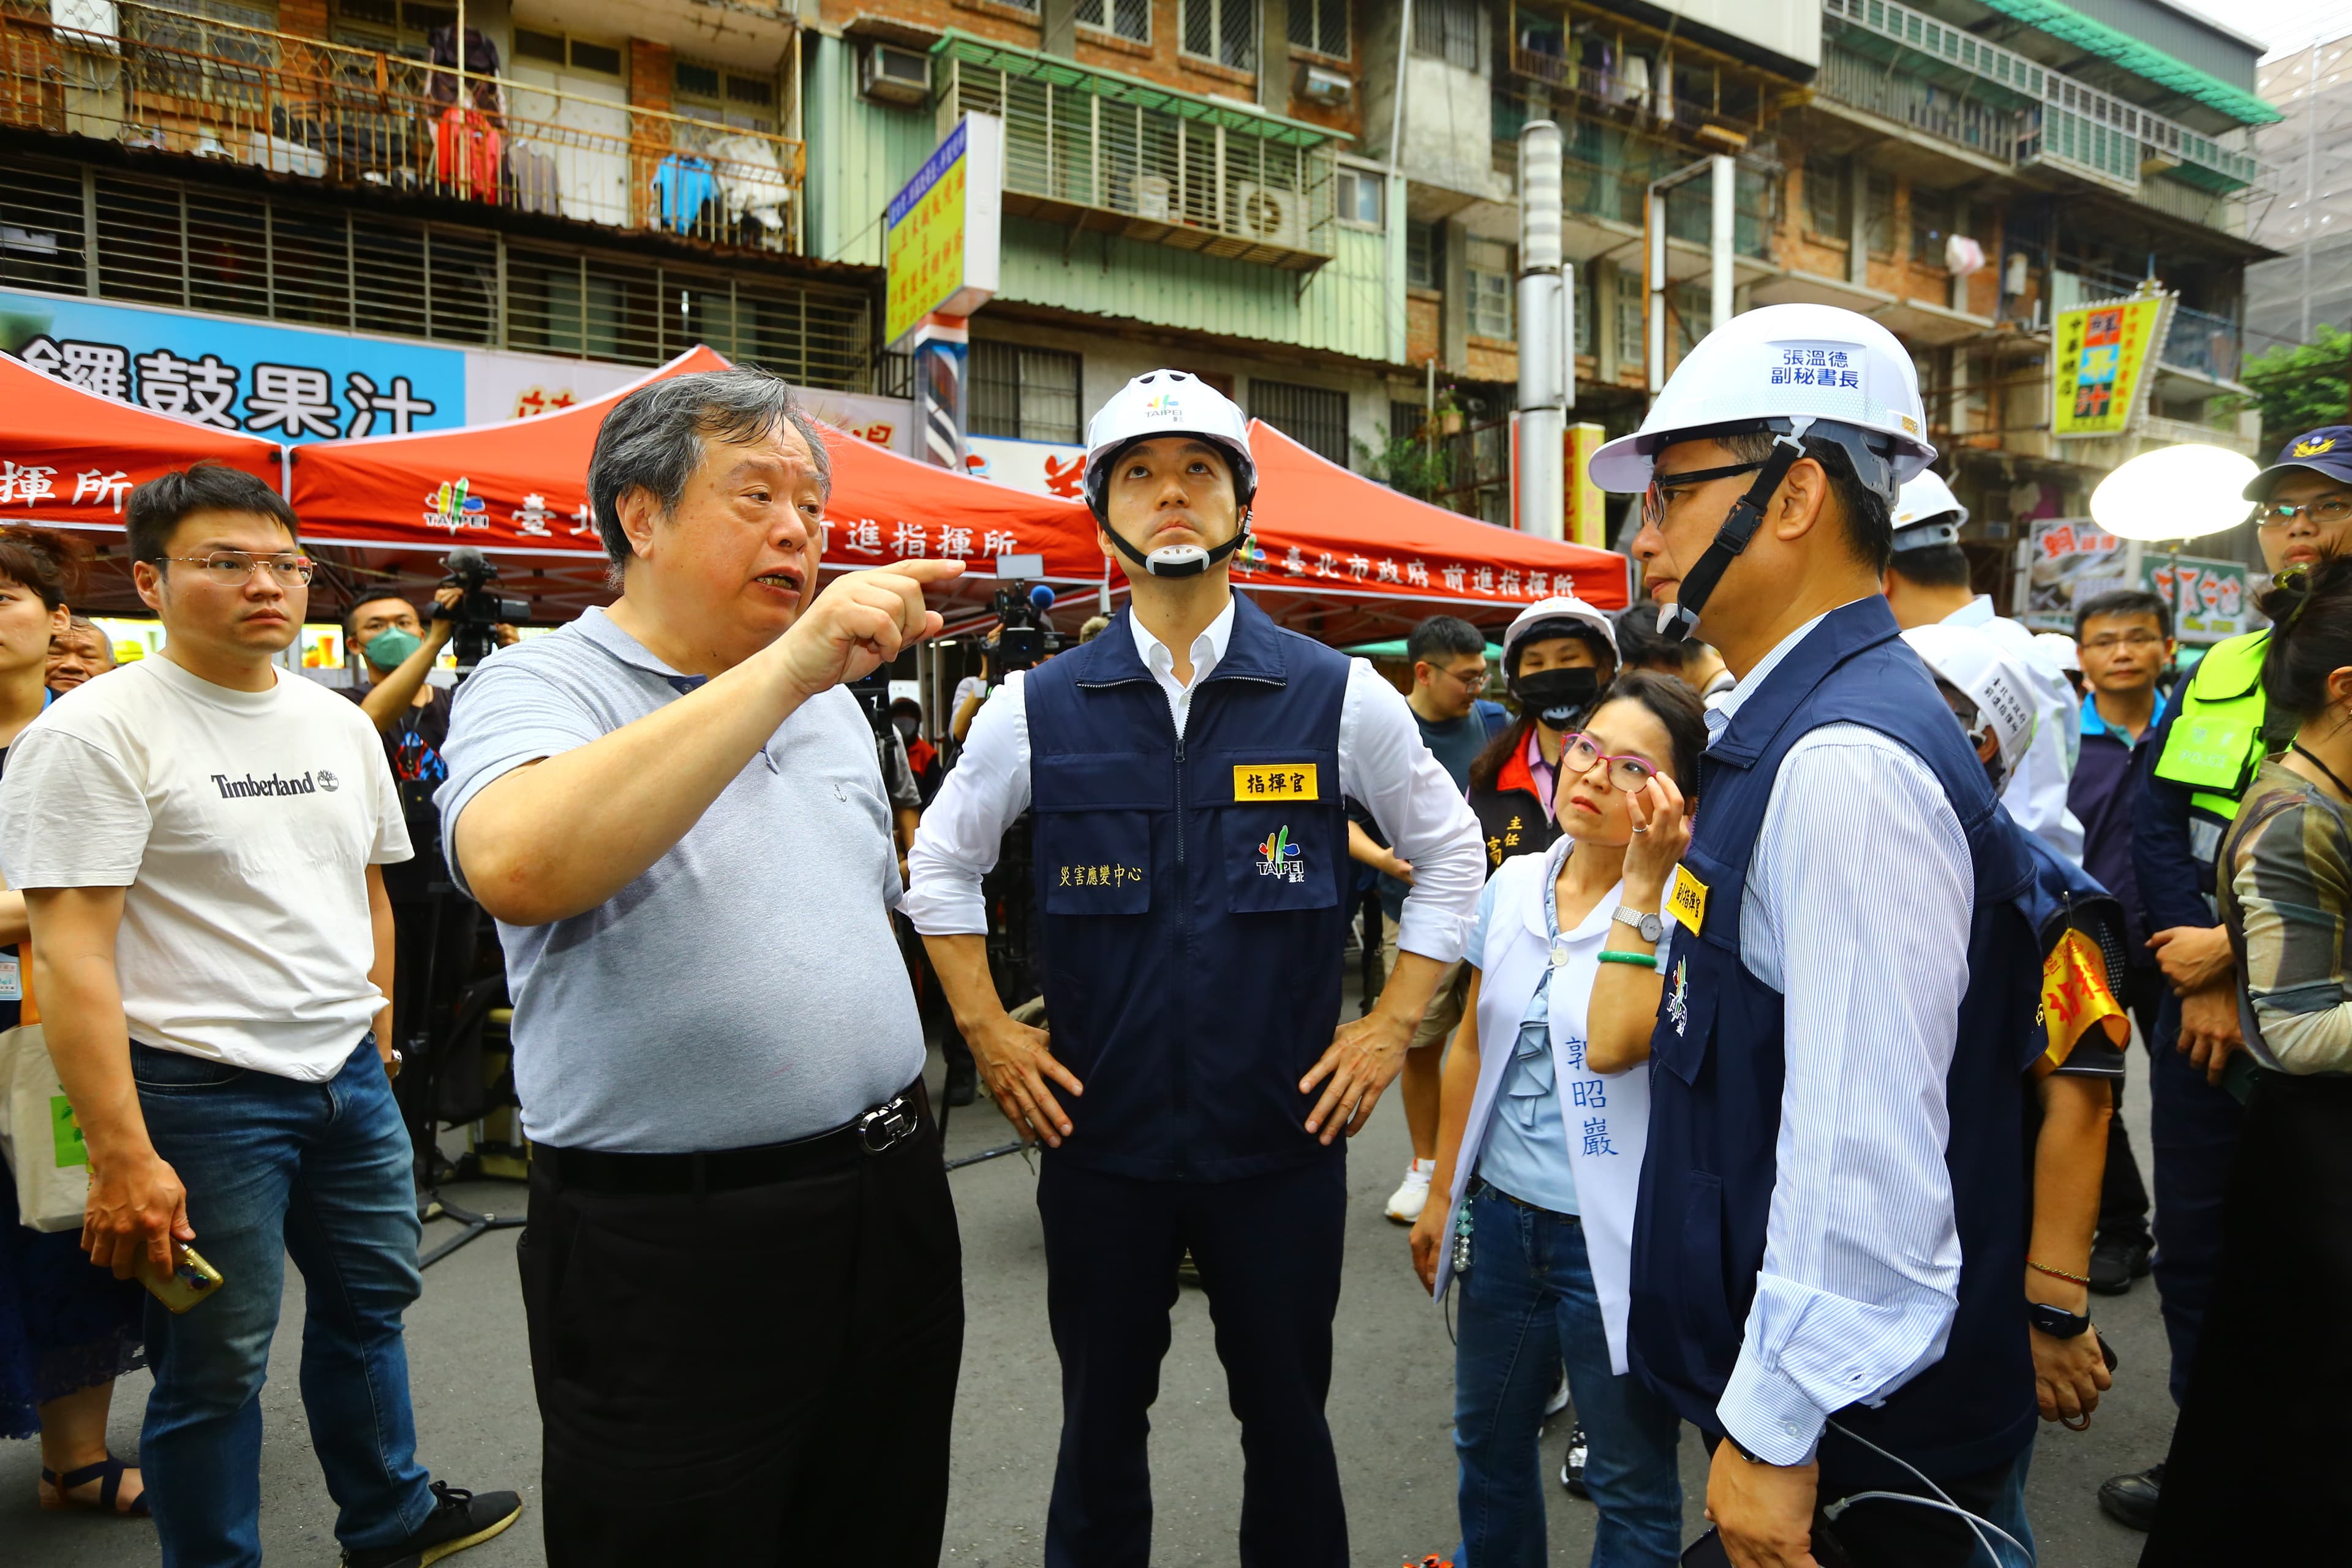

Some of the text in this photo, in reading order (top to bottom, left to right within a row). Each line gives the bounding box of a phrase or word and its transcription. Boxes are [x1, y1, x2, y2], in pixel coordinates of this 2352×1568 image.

[1783, 349, 1849, 368] 張溫德
[1771, 366, 1860, 390] 副秘書長
[1144, 409, 1183, 418] TAIPEI
[423, 512, 489, 530] TAIPEI
[2179, 749, 2227, 769] POLICE
[211, 771, 316, 799] Timberland
[1246, 772, 1306, 794] 指揮官
[1504, 815, 1523, 847] 主任
[1058, 864, 1142, 888] 災害應變中心
[1256, 861, 1304, 876] TAIPEI
[1676, 883, 1701, 918] 副指揮官
